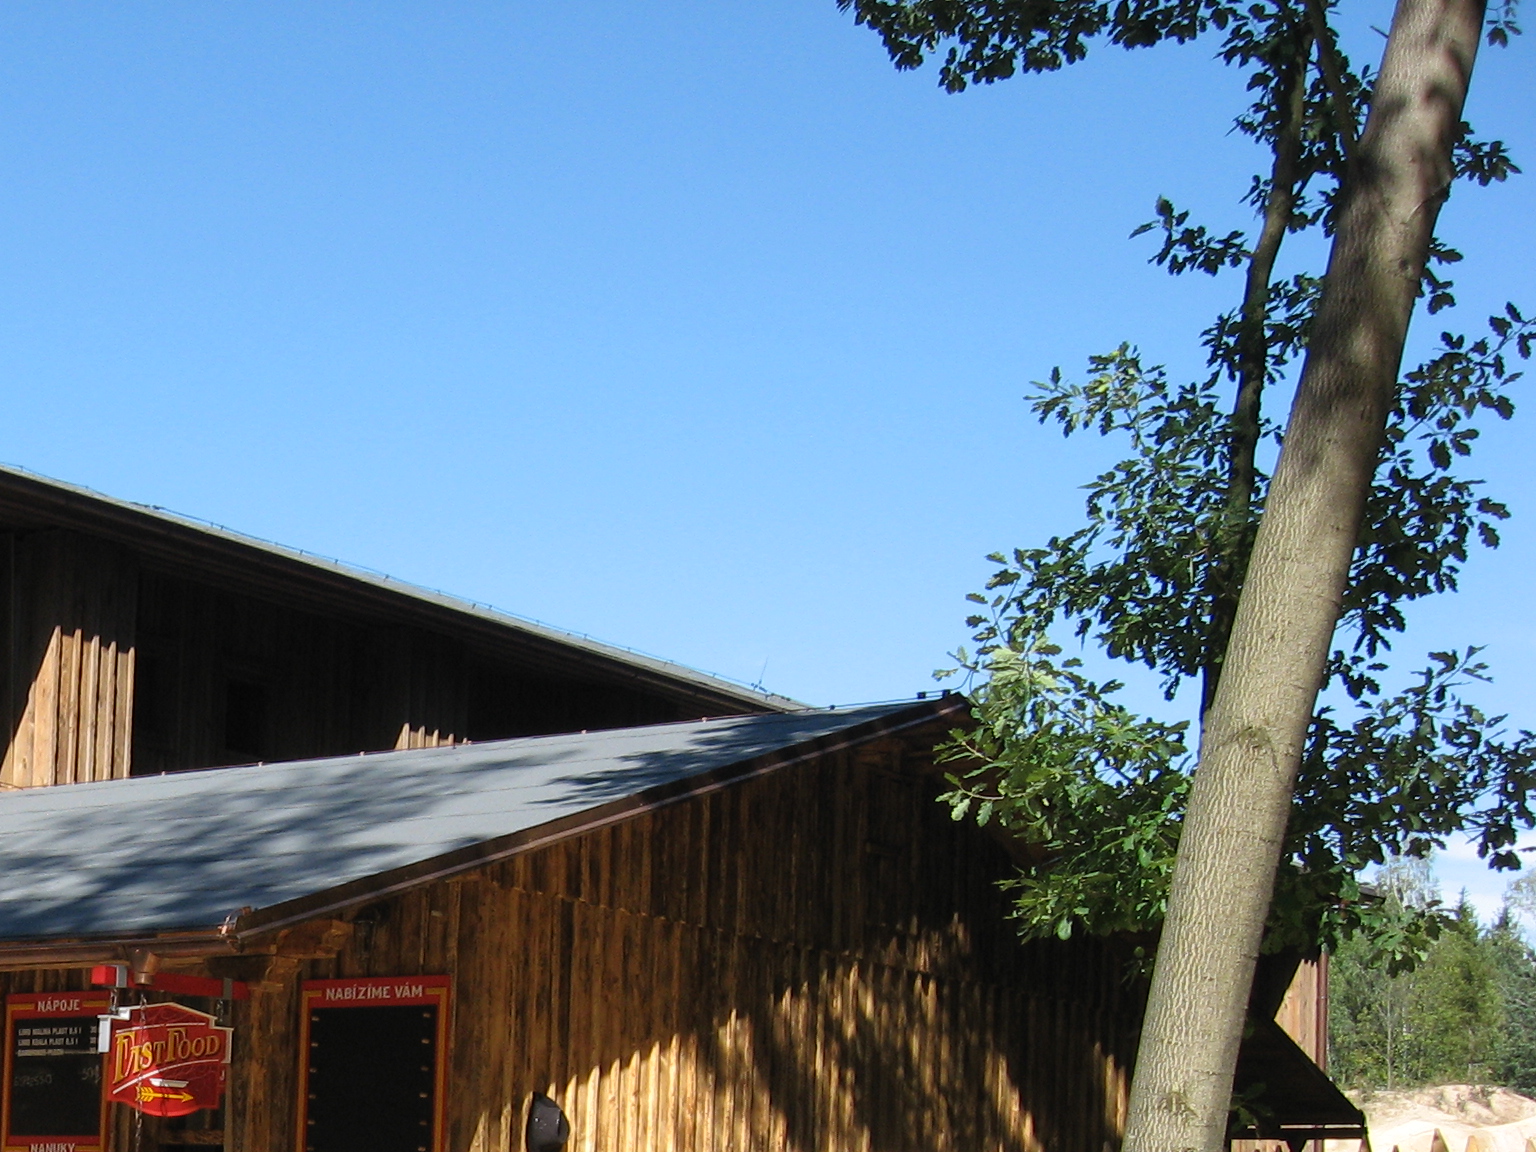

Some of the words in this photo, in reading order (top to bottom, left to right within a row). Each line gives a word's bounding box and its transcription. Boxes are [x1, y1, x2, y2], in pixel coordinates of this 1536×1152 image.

[325, 983, 391, 1001] NABÍZÍME
[394, 981, 423, 998] VÁM
[37, 996, 81, 1012] NÁPOJE
